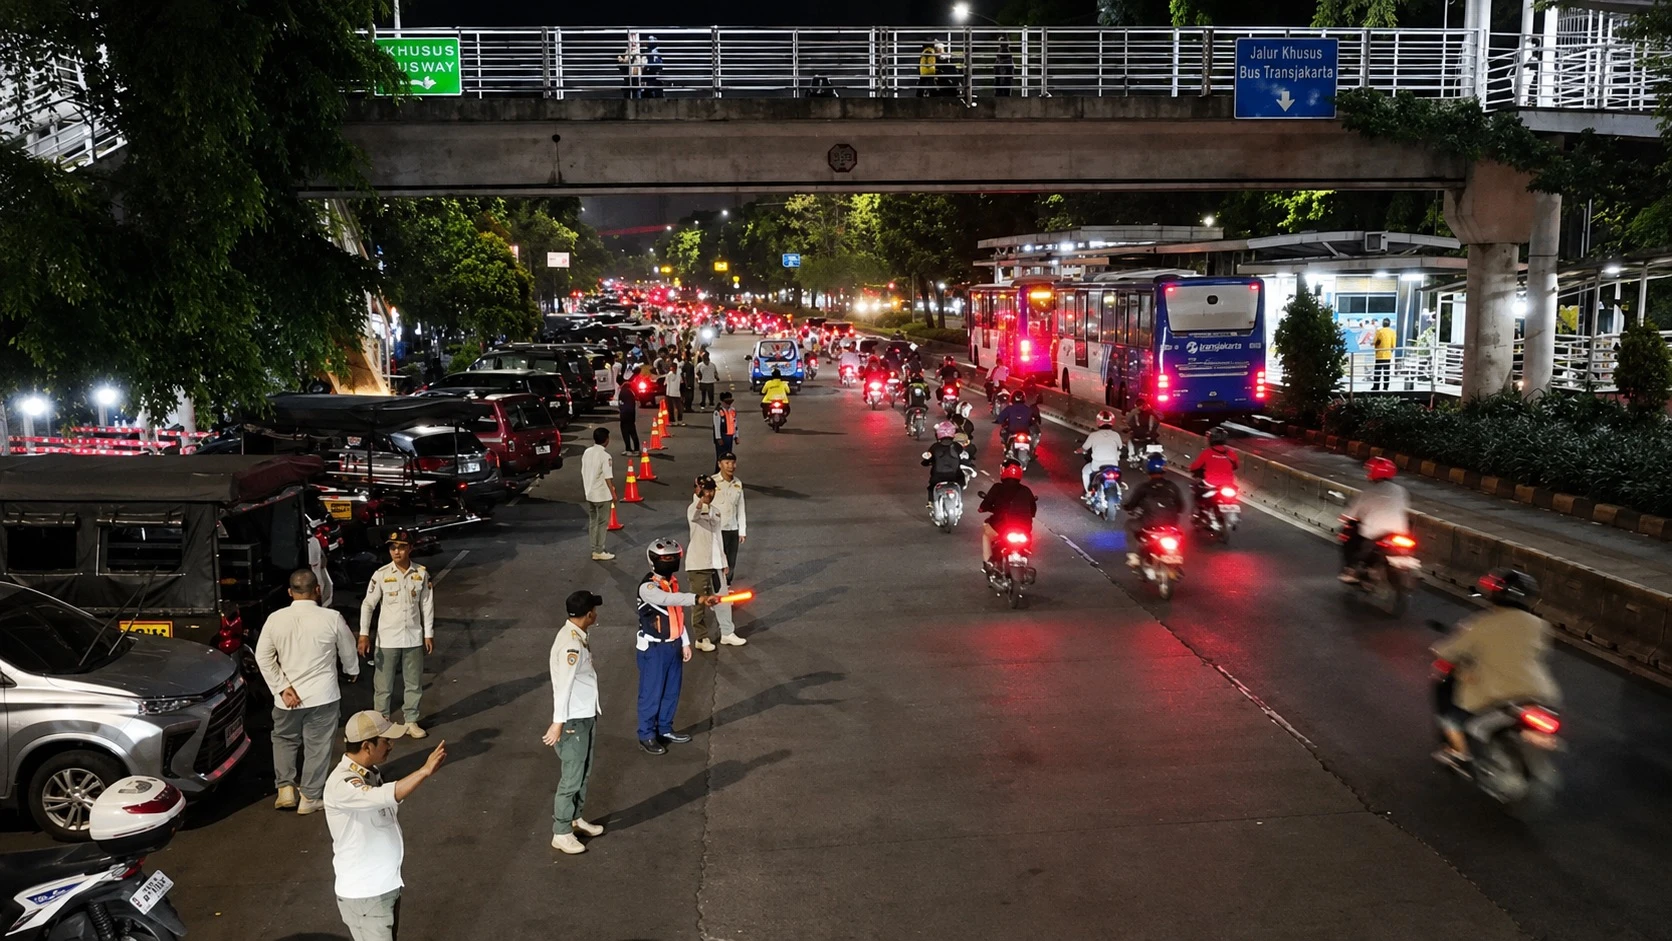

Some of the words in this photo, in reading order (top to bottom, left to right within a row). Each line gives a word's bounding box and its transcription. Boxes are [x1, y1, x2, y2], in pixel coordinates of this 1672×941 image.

[386, 45, 454, 56] KHUSUS
[1250, 46, 1278, 59] Jalur
[1282, 46, 1323, 59] Khusus
[397, 61, 455, 73] USWAY
[1240, 65, 1260, 79] Bus
[1263, 65, 1333, 82] Transjakarta
